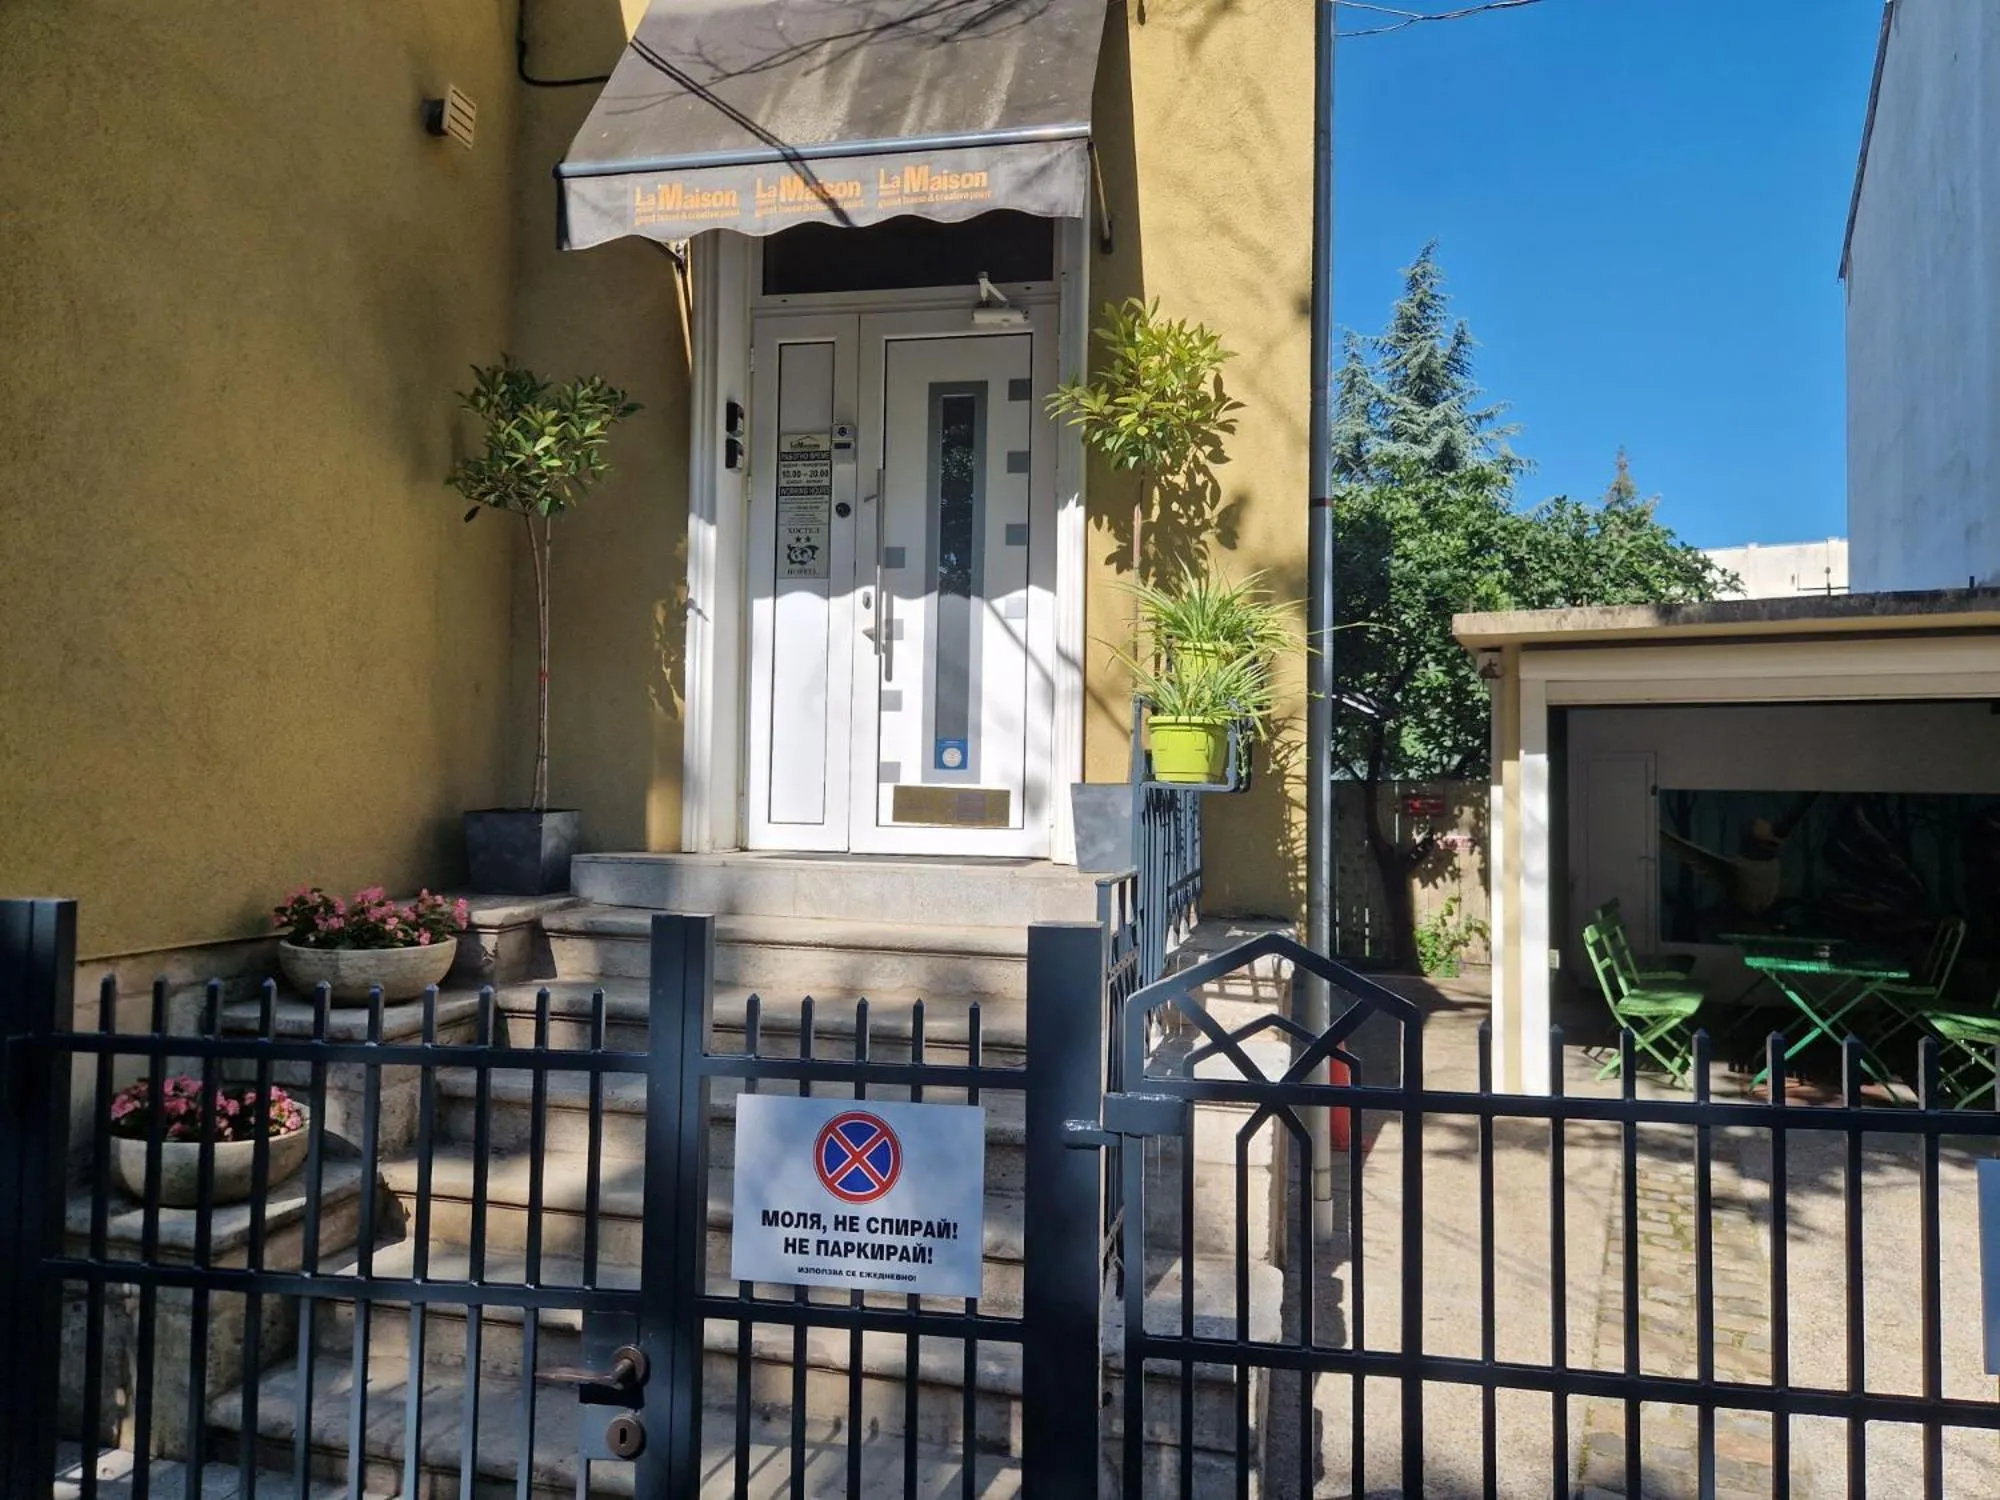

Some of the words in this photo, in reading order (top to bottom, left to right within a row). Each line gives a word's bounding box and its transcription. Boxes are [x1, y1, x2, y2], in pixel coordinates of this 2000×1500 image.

[761, 1209, 827, 1234] МОЛЯ,
[834, 1214, 860, 1233] НЕ
[866, 1216, 958, 1239] СПИРАЙ!
[783, 1237, 809, 1256] НЕ
[816, 1239, 933, 1264] ПАРКИРАЙ!
[797, 1266, 843, 1276] ИЗПОЛЗВА
[845, 1269, 857, 1278] СЕ
